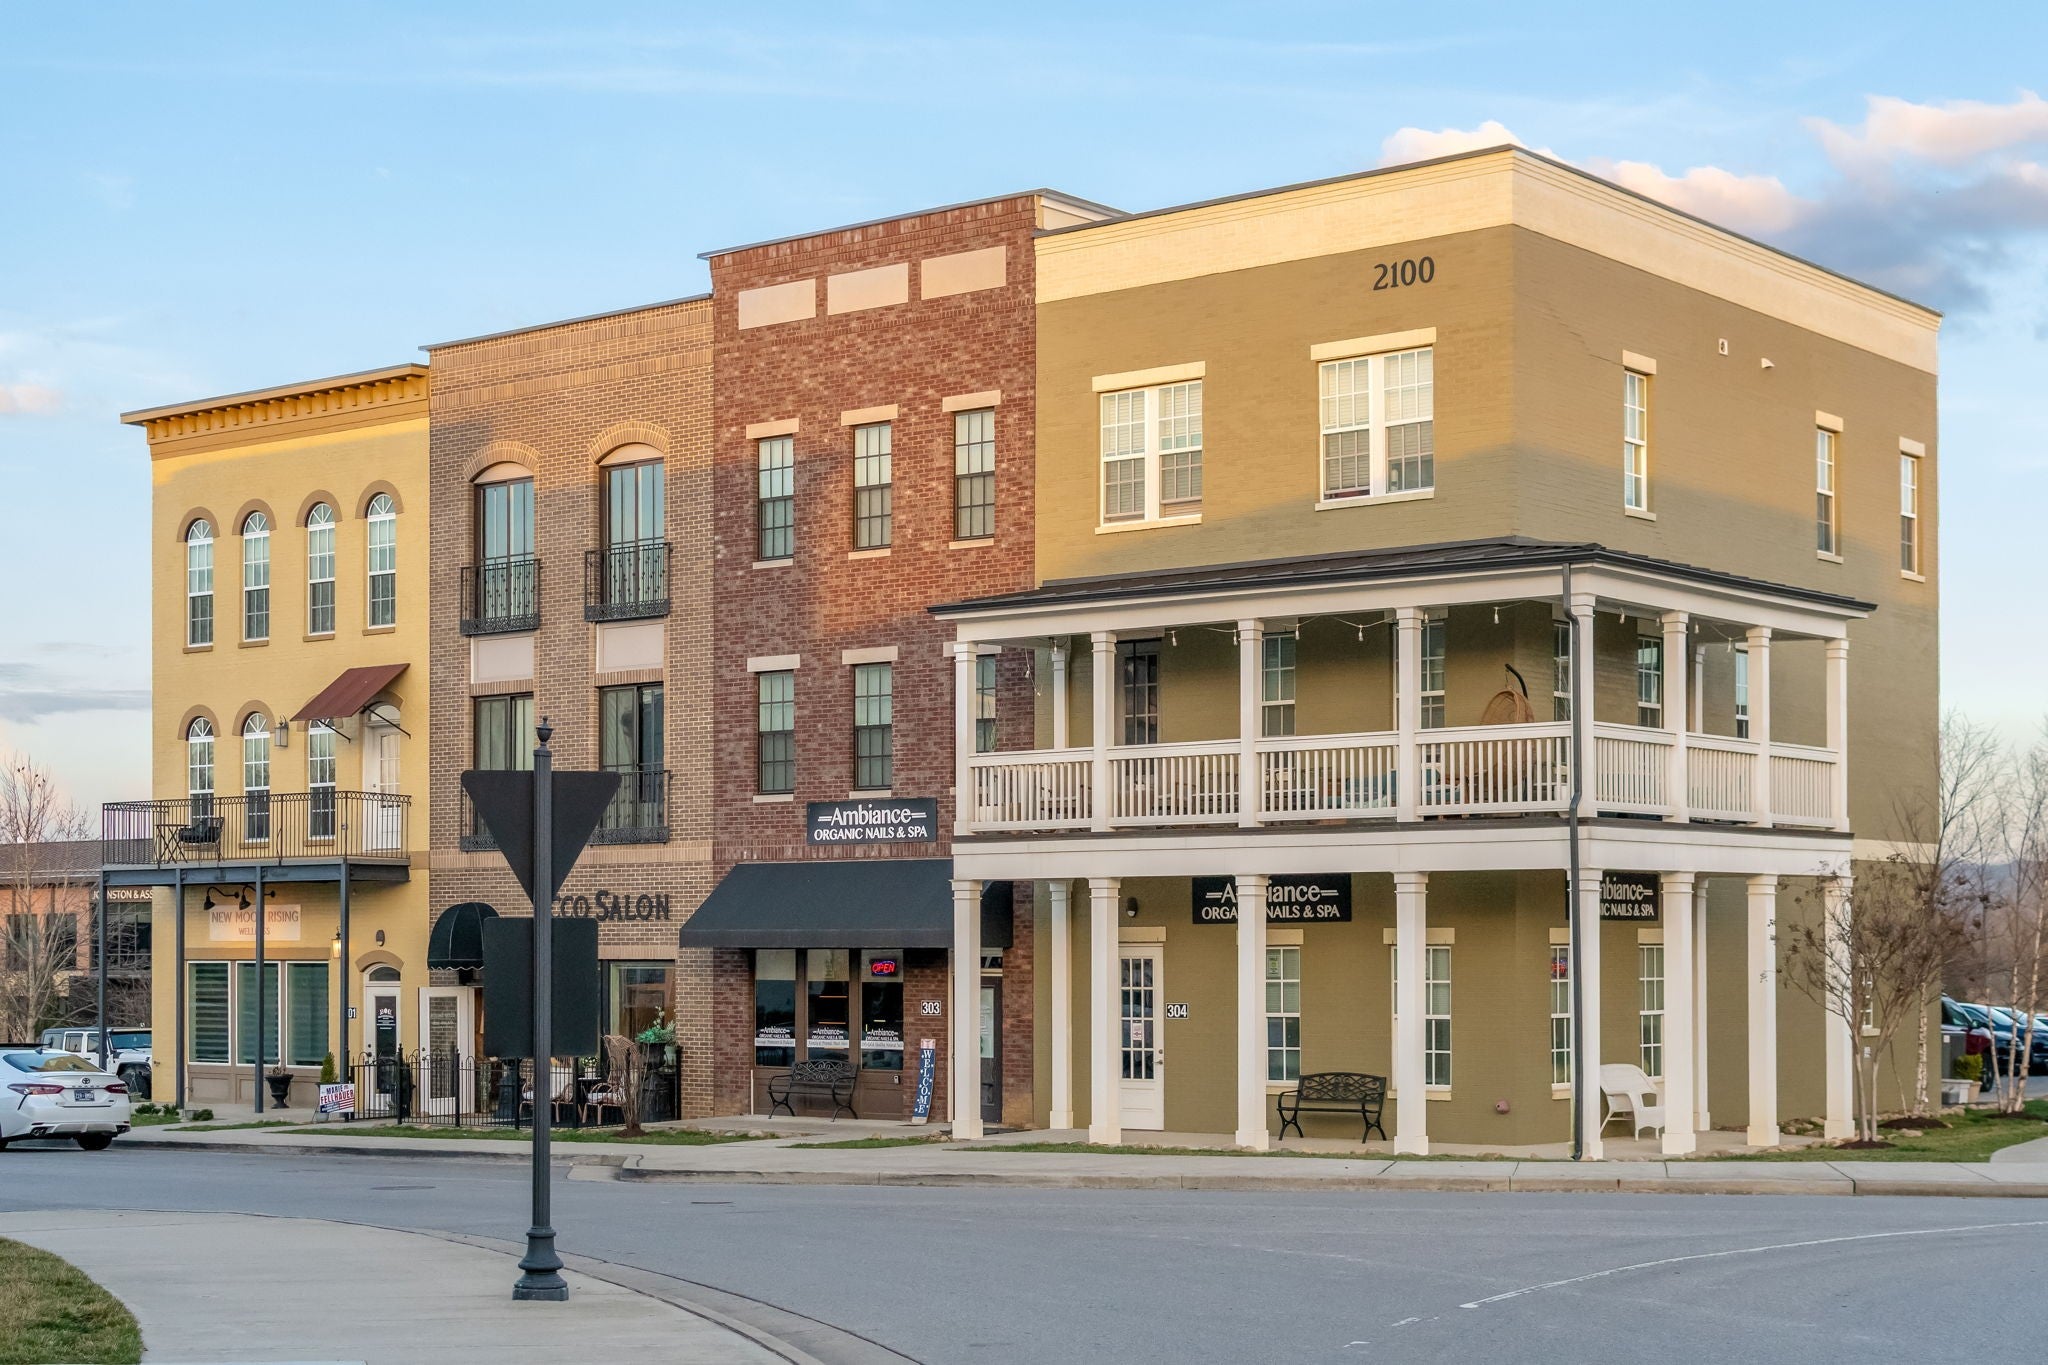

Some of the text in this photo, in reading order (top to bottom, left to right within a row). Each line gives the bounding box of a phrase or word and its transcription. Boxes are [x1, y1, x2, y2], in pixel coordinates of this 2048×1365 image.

[1373, 256, 1435, 290] 2100
[830, 803, 912, 826] Ambiance
[814, 825, 928, 840] ORGANIC NAILS & SPA
[92, 890, 132, 900] JONSTON
[133, 890, 139, 899] &
[1220, 879, 1322, 903] Aiance
[595, 889, 670, 921] SALON
[1201, 904, 1341, 920] ORGA NAILS & SPA
[1610, 903, 1633, 916] NAILS
[1633, 903, 1641, 916] &
[1641, 903, 1655, 916] SPA
[211, 910, 299, 923] NEW MOO RISING
[238, 927, 271, 936] WELLSS
[872, 963, 896, 973] OPEN
[922, 1002, 940, 1014] 303
[1167, 1004, 1188, 1017] 304
[918, 1050, 933, 1114] WELCOME
